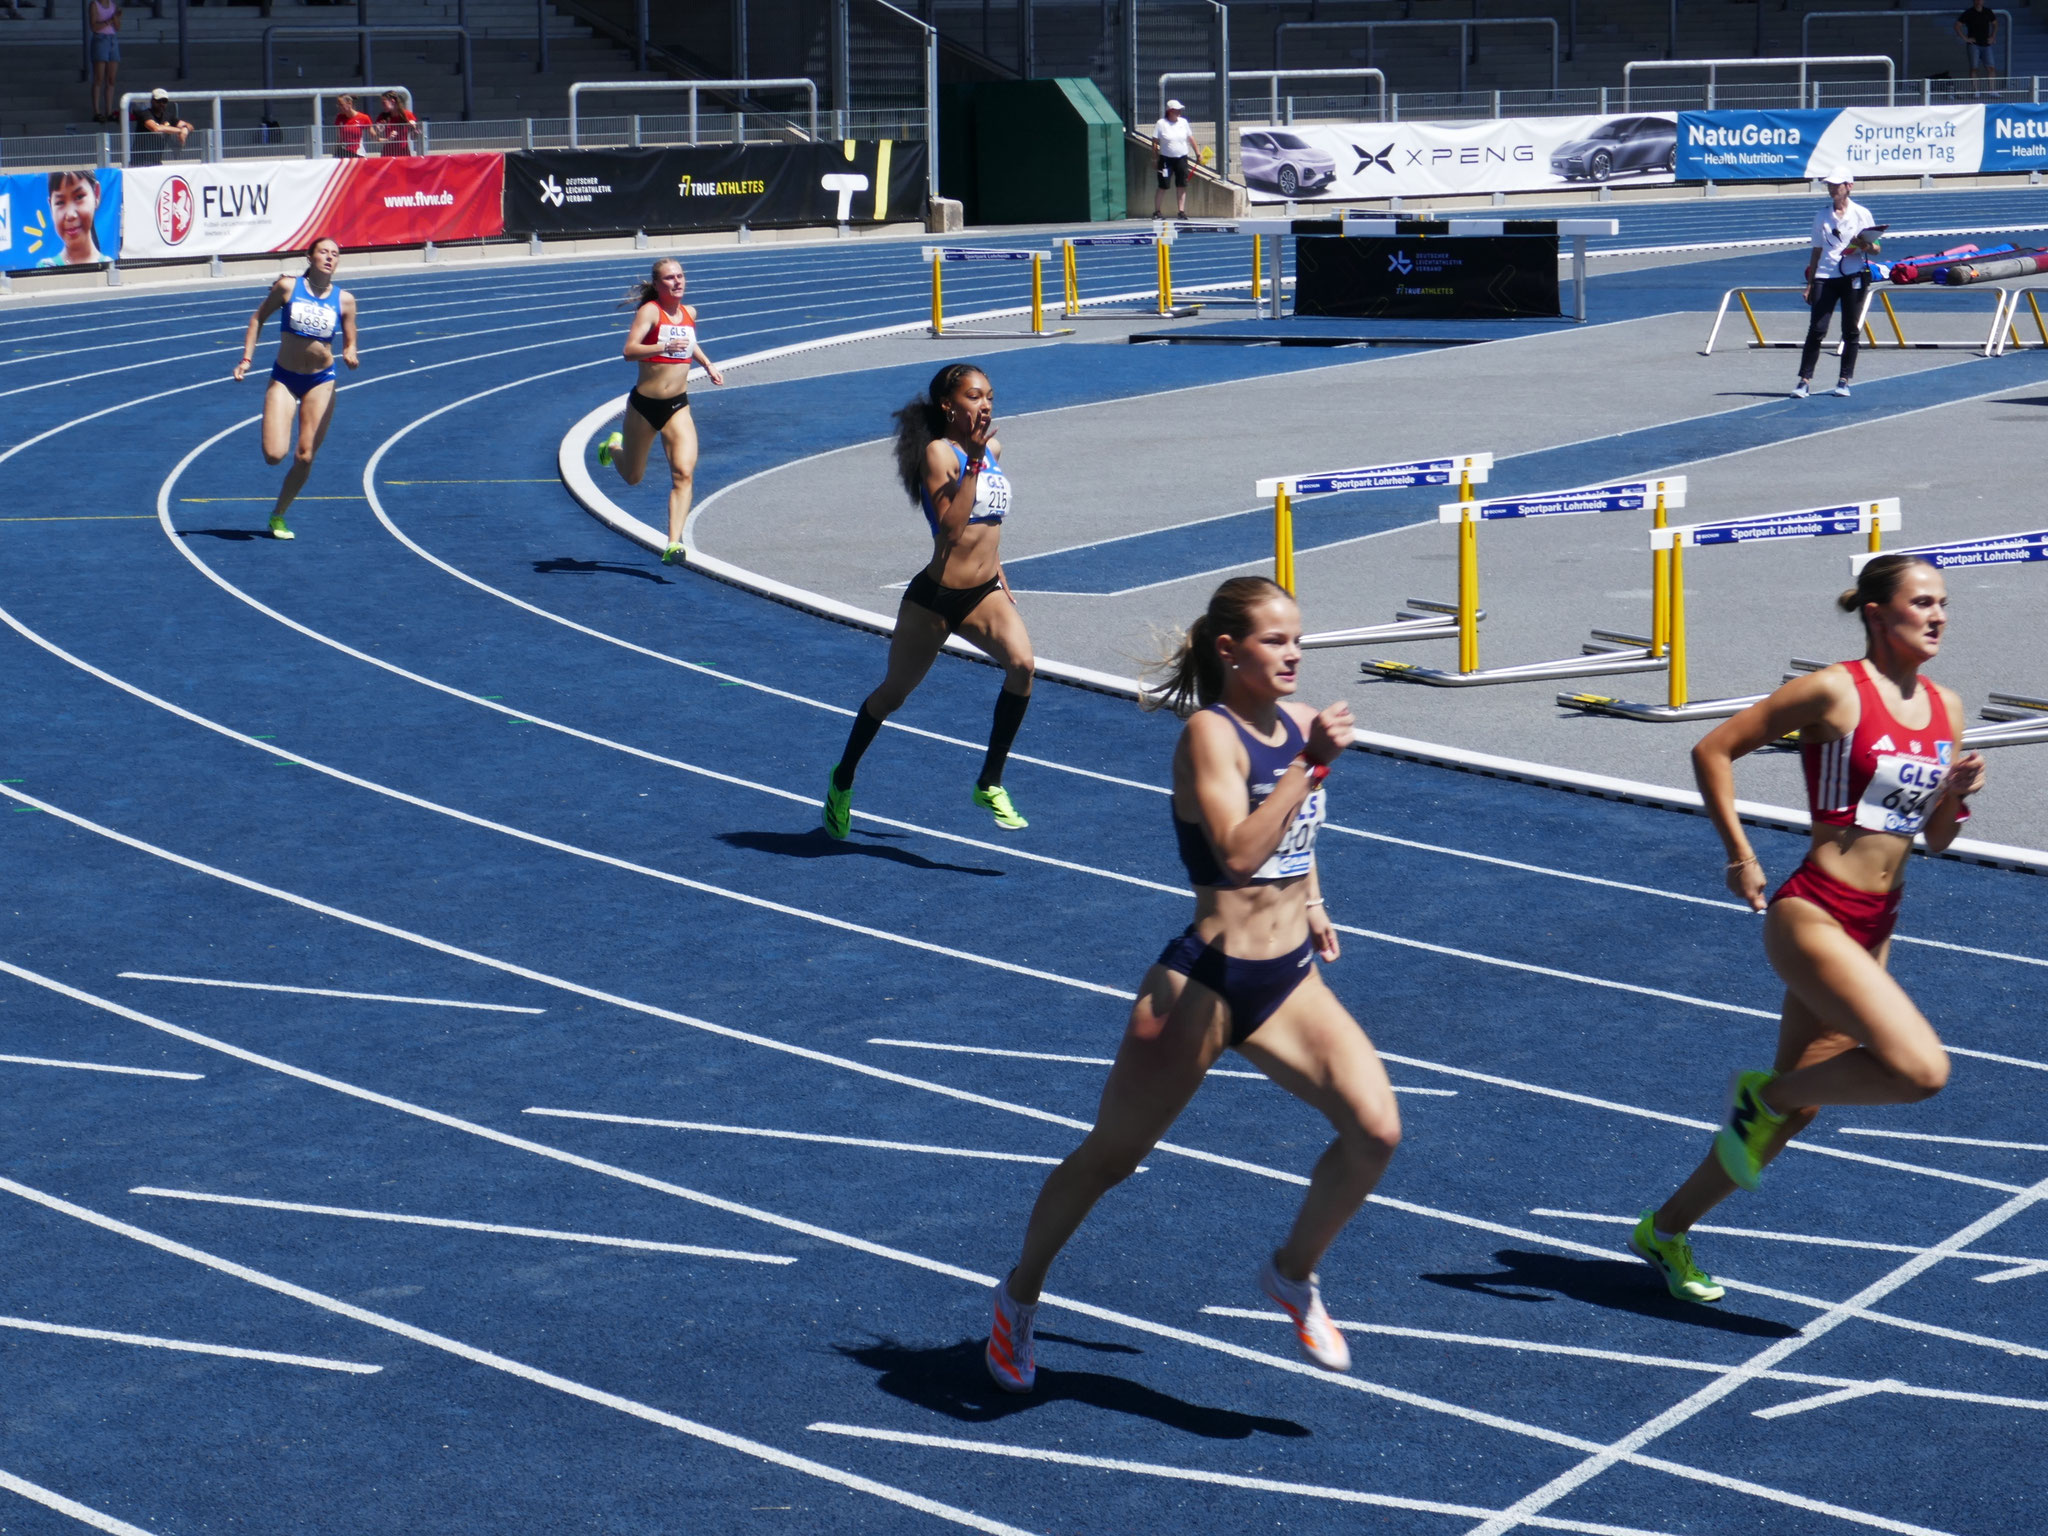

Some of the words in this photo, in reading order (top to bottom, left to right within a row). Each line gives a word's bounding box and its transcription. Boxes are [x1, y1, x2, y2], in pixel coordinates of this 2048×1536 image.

[1689, 123, 1800, 146] NatuGena
[1855, 121, 1956, 143] Sprungkraft
[1406, 145, 1534, 166] XPENG
[1704, 152, 1737, 165] Health
[1739, 151, 1784, 164] Nutrition
[1847, 144, 1871, 161] für
[1875, 144, 1922, 165] jeden
[1928, 143, 1955, 163] Tag
[2012, 144, 2047, 156] Health
[565, 177, 598, 186] DEUTSCHER
[565, 185, 612, 194] LEICHTATHLETIK
[203, 183, 270, 218] FLVW
[384, 190, 454, 208] www.flvw.de
[565, 194, 593, 203] VERBAND
[303, 305, 324, 316] GLS
[296, 313, 329, 330] 1683
[670, 327, 687, 337] GLS
[1331, 477, 1373, 490] Sportpark
[1374, 475, 1415, 487] Lohrheide
[988, 491, 1007, 510] 215
[1518, 502, 1562, 516] Sportpark
[1563, 500, 1608, 512] Lohrheide
[1731, 526, 1776, 540] Sportpark
[1777, 523, 1823, 536] Lohrheide
[1936, 552, 1982, 567] Sportpark
[1983, 549, 2031, 562] Lohrheide
[1899, 763, 1942, 789] GLS
